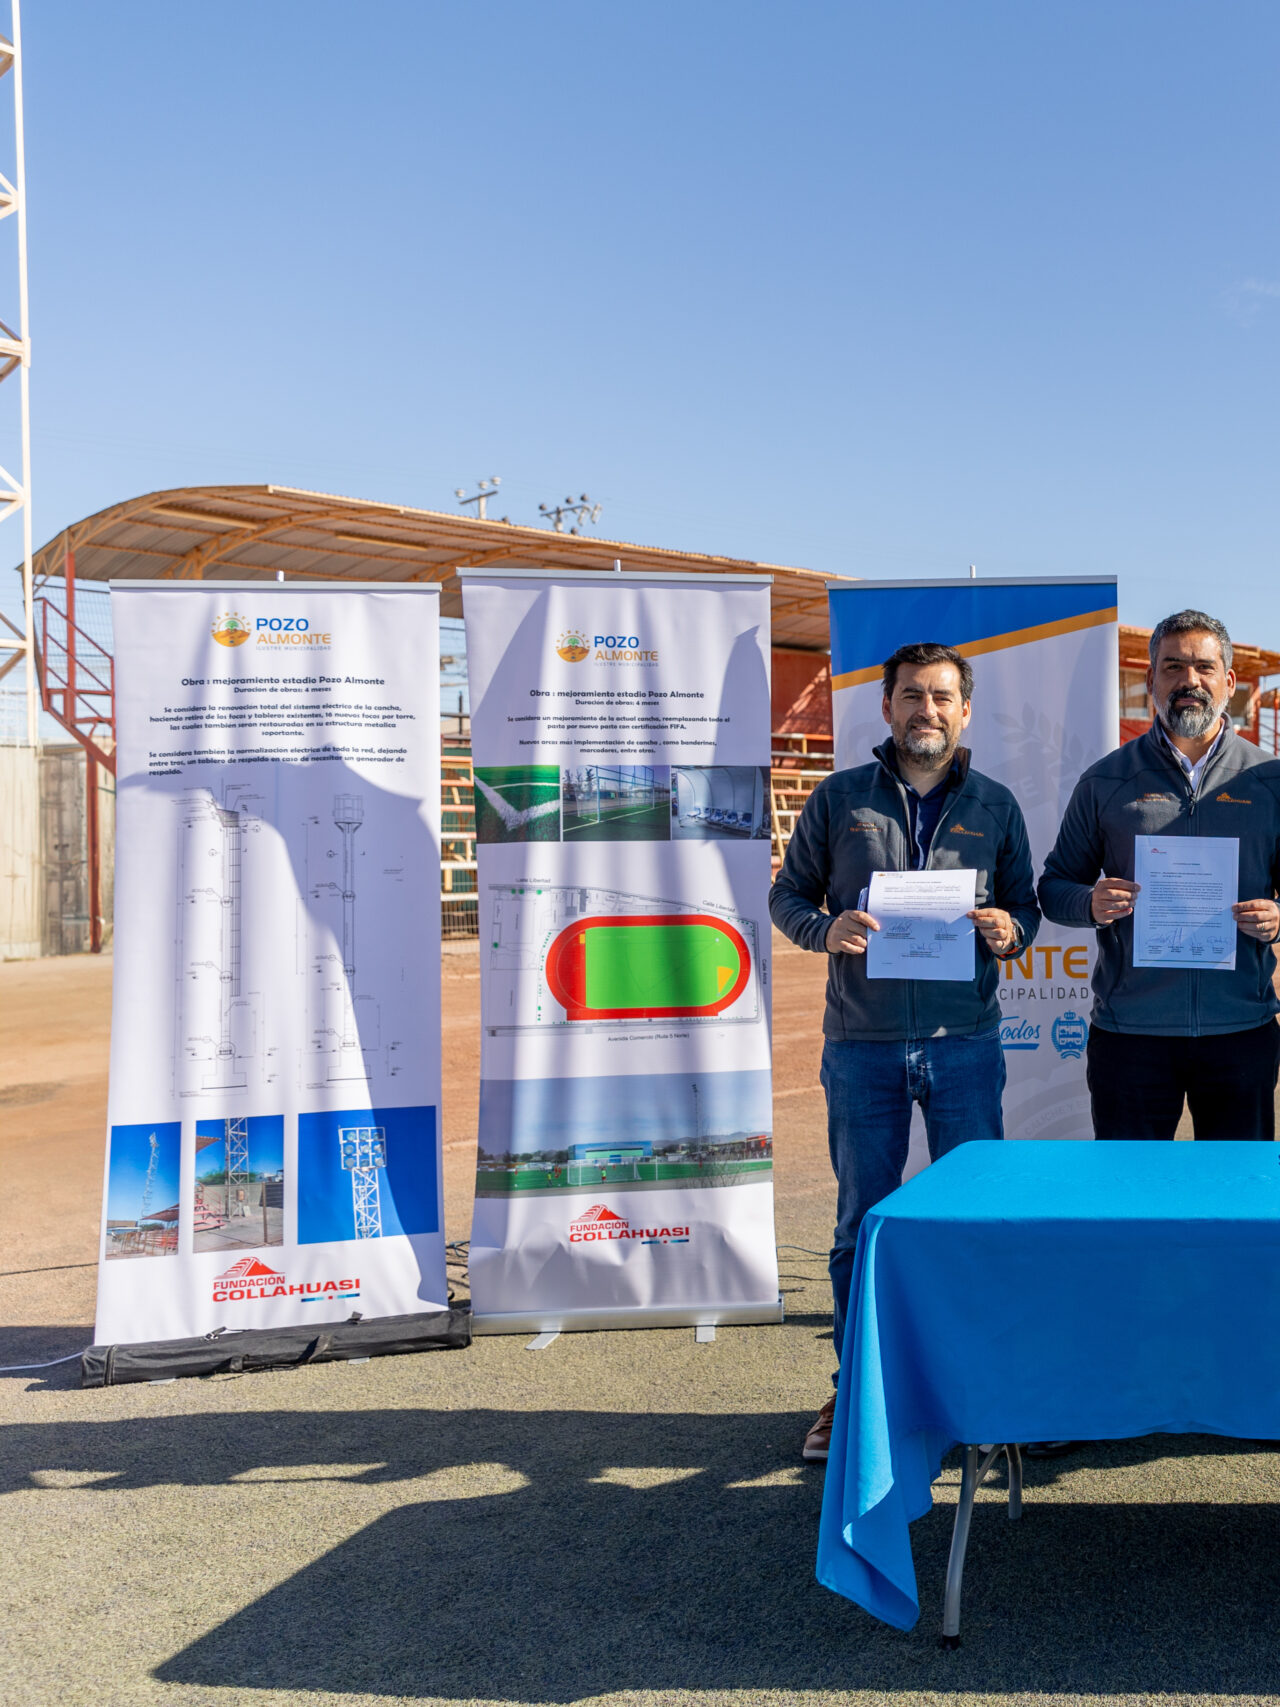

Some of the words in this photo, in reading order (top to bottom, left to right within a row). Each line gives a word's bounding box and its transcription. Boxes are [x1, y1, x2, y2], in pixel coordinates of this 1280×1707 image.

[256, 618, 309, 631] POZO
[257, 633, 331, 644] ALMONTE
[594, 636, 639, 648] POZO
[595, 650, 658, 661] ALMONTE
[182, 678, 204, 686] Obra
[213, 677, 280, 686] mejoramiento
[319, 676, 342, 684] Pozo
[345, 676, 384, 685] Almonte
[557, 690, 615, 698] mejoramiento
[174, 705, 206, 713] considera
[1000, 987, 1088, 1000] CIPALIDAD
[570, 1221, 629, 1232] FUNDACIÓN
[570, 1227, 689, 1242] COLLAHUASI
[213, 1276, 285, 1290] FUNDACIÓN
[212, 1278, 360, 1302] COLLAHUASI
